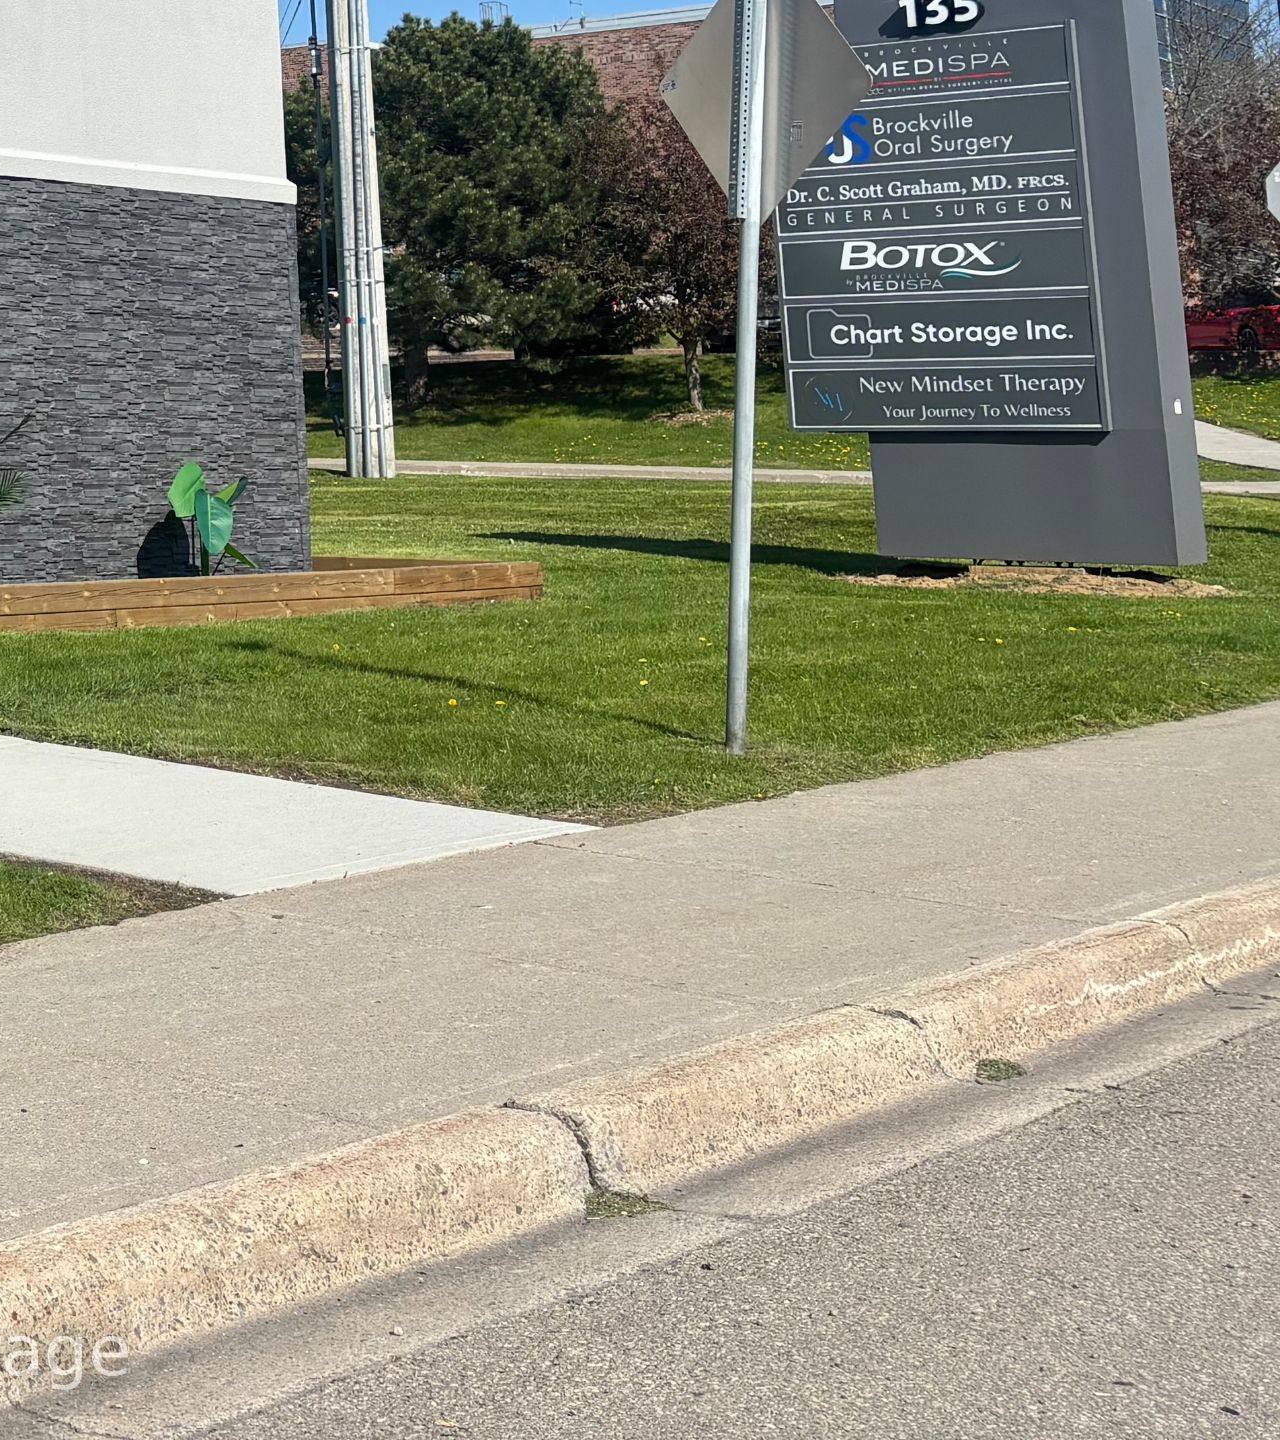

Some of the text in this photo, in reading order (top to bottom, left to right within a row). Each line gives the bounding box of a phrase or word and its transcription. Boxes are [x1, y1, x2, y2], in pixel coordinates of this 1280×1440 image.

[864, 38, 1009, 58] BROCKVILLE
[865, 51, 1010, 78] MEDISPA
[872, 109, 973, 135] Brockville
[874, 134, 1013, 157] Oral Surgery
[786, 173, 1070, 204] Dr. C. Scott Graham, MD. FRCS.
[787, 196, 1072, 227] GENERAL SURGEON
[856, 272, 928, 281] BROCKVILLE
[856, 279, 944, 292] MEDISPA
[830, 319, 1075, 347] Chart Storage Inc.
[859, 374, 1086, 395] New Mindset Therapy
[883, 404, 1072, 421] Your Journey To Wellness
